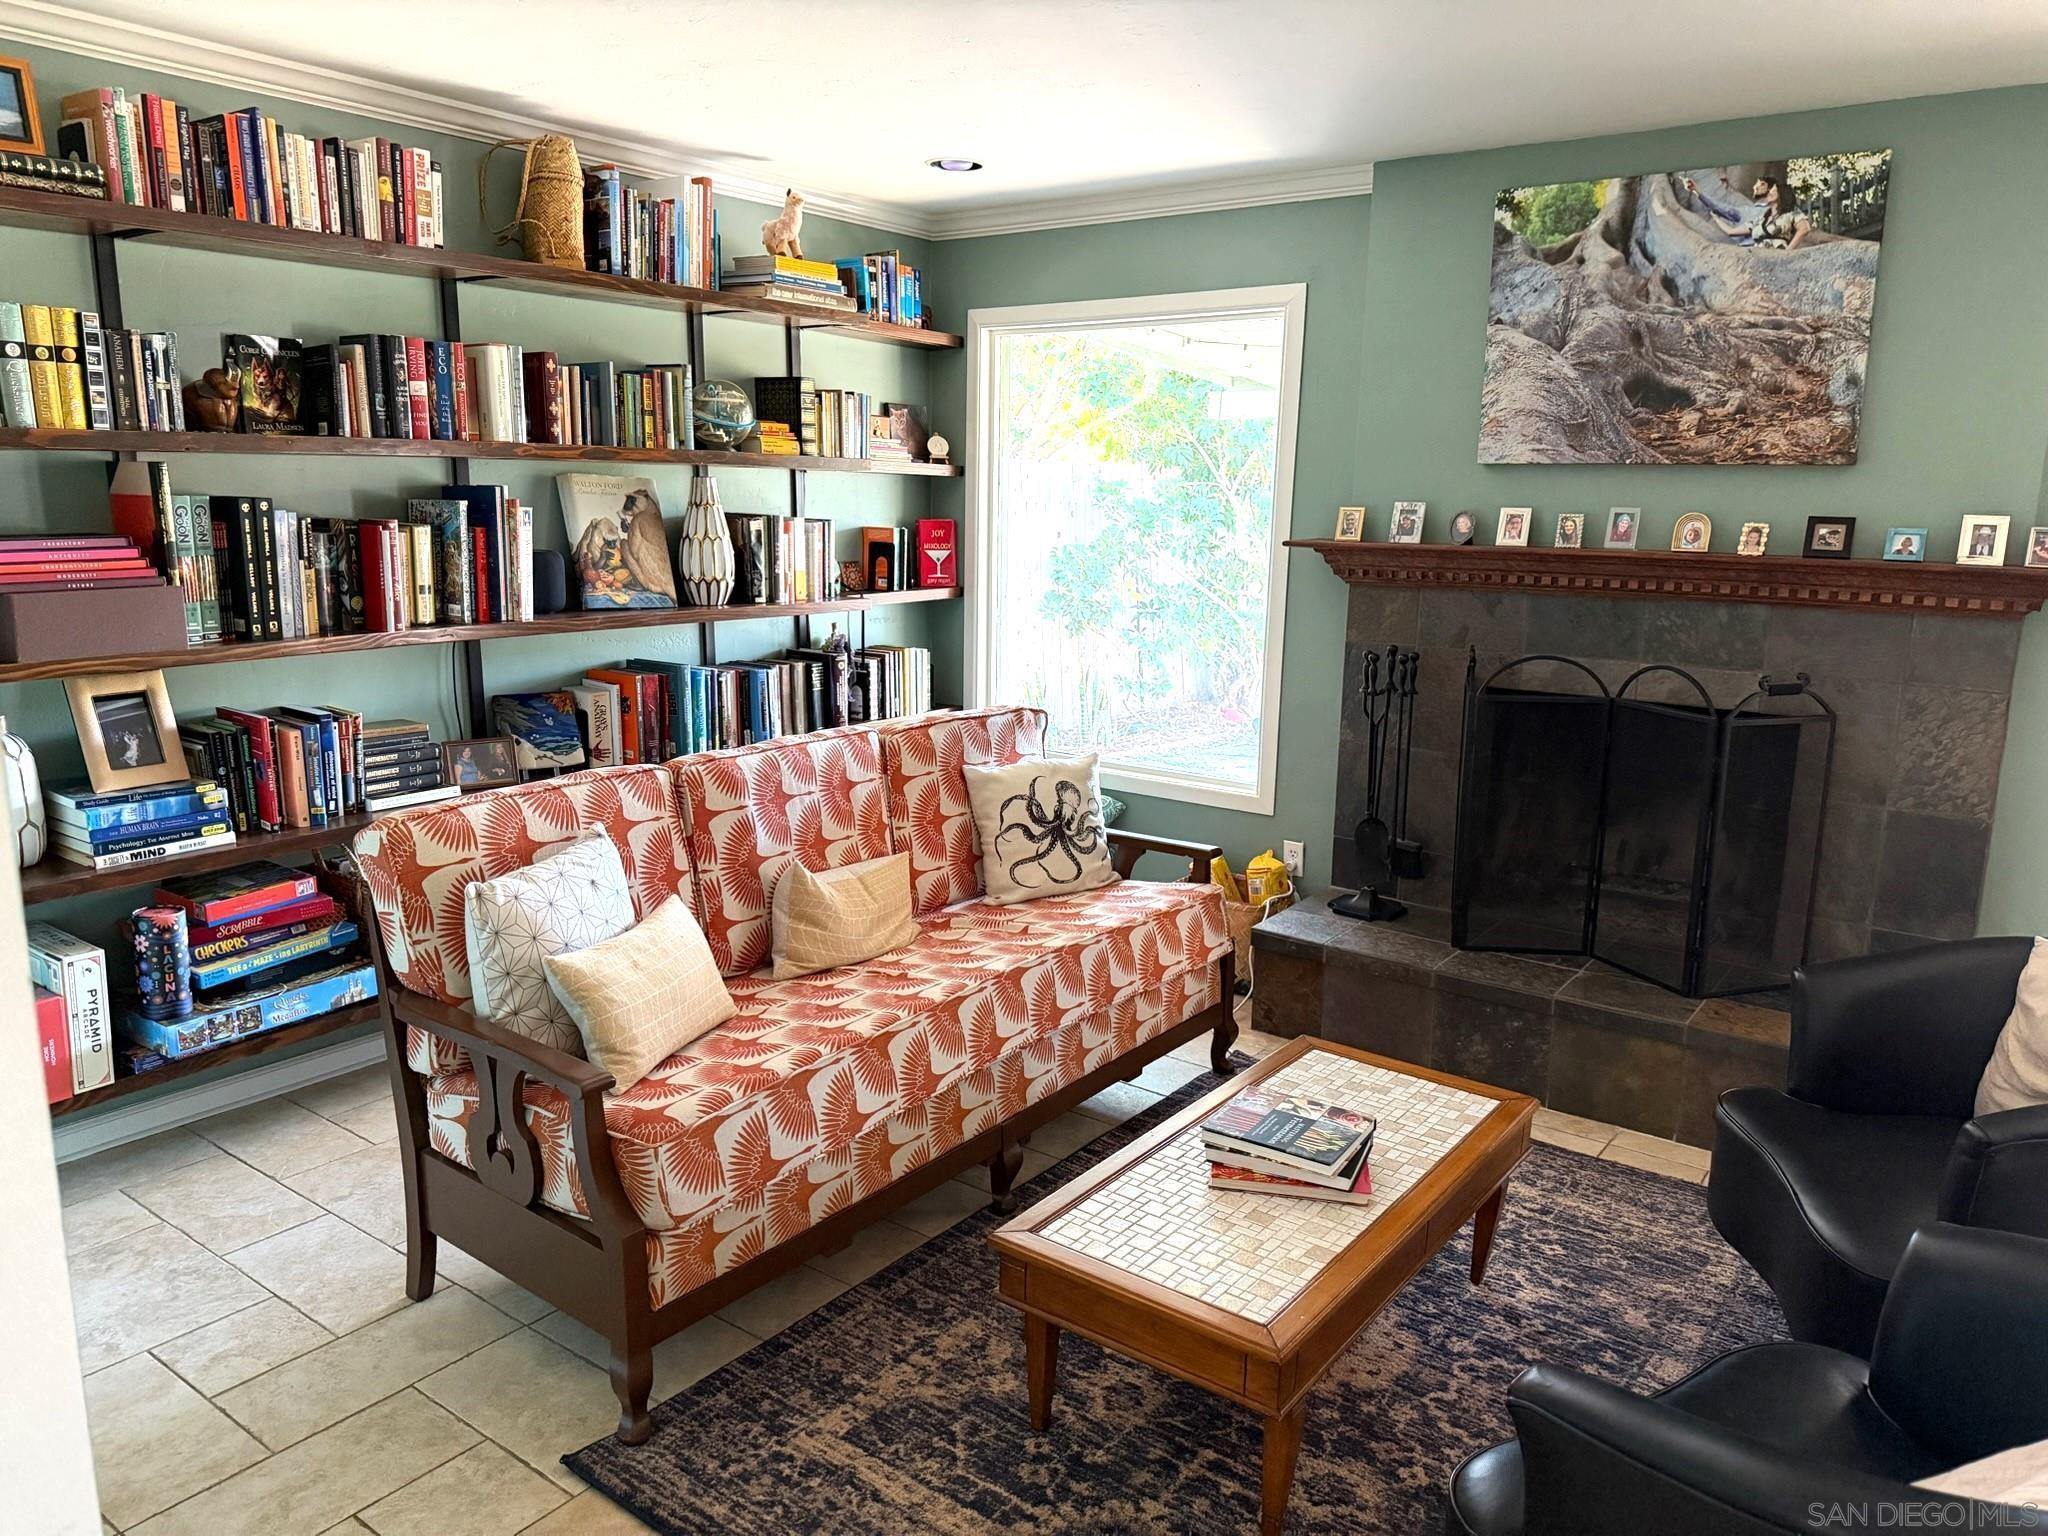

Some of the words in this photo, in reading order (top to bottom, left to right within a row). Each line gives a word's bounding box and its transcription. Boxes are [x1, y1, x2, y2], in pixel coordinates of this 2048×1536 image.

[216, 167, 224, 190] Salt
[232, 165, 240, 190] CHAOS
[416, 154, 426, 187] PRIZE
[113, 334, 124, 370] ANATHEM
[408, 346, 418, 378] IRVING
[439, 348, 448, 374] ECO
[36, 366, 50, 417] Confusion
[575, 480, 604, 488] WALTON
[604, 481, 623, 489] FORD
[593, 699, 602, 739] ANATOMY
[600, 704, 608, 730] GRAY'S
[242, 735, 250, 762] Subliminal
[120, 824, 141, 834] HUMAN
[142, 822, 159, 831] BRAIN
[108, 839, 146, 850] Psychology:
[130, 847, 166, 861] MIND
[216, 916, 263, 938] SCRABBLE
[194, 934, 249, 961] CHECKERS
[227, 963, 242, 975] THE
[253, 954, 274, 967] MAZE
[292, 937, 328, 954] LABYRINTH
[164, 946, 176, 1001] LACUNA
[86, 989, 102, 1053] PYRAMID
[271, 1008, 310, 1024] MegaBox
